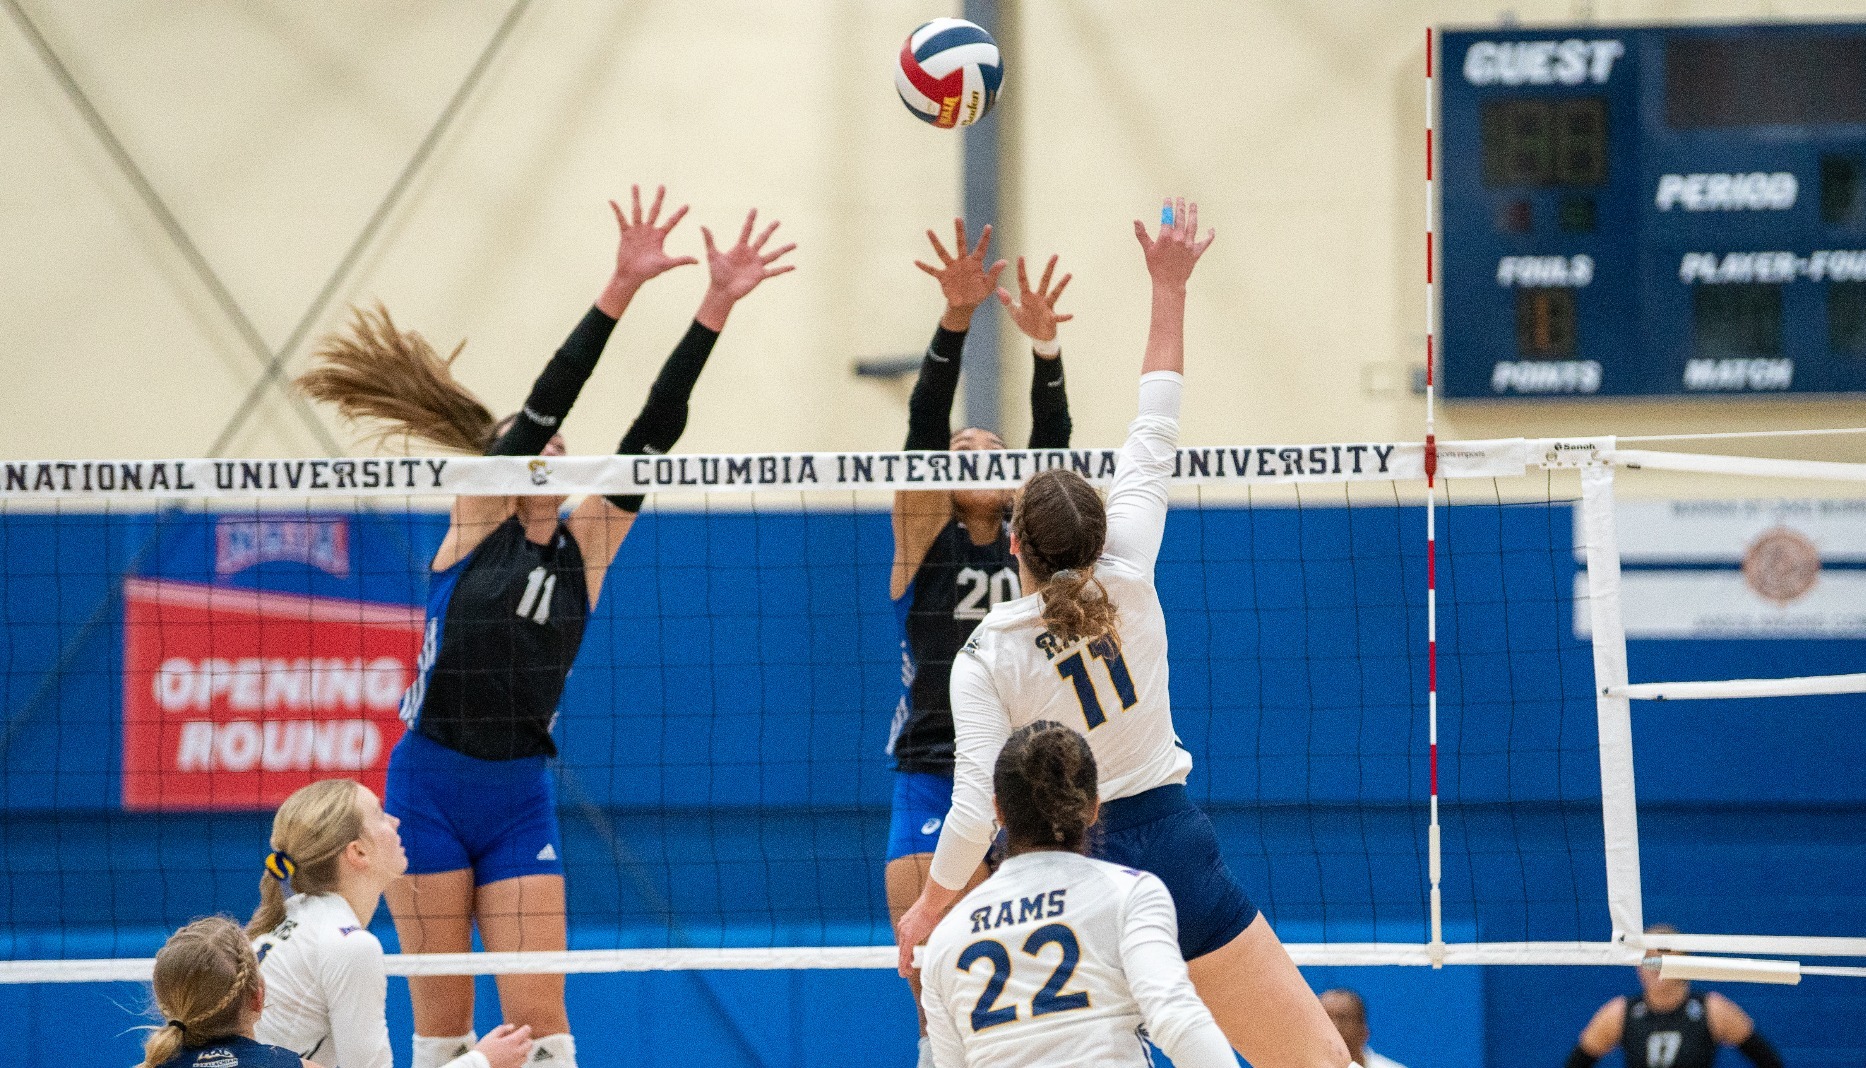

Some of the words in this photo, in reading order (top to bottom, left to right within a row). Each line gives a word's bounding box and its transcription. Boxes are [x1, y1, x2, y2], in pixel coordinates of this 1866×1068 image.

[1464, 39, 1624, 86] GUEST
[1656, 172, 1798, 211] PERIOD
[1497, 255, 1594, 287] FOULS
[1491, 361, 1602, 393] POINTS
[1684, 358, 1793, 390] MATCH
[2, 461, 195, 491] NATIONAL
[215, 459, 448, 490] UNIVERSITY
[632, 455, 819, 486] COLUMBIA
[837, 449, 1117, 484] INTERNATIONA
[516, 566, 557, 625] 11
[953, 567, 1022, 620] 20
[153, 657, 406, 712] OPENING
[1056, 632, 1138, 731] 11
[176, 719, 383, 772] ROUND
[970, 889, 1067, 934] RAMS
[956, 922, 1091, 1032] 22
